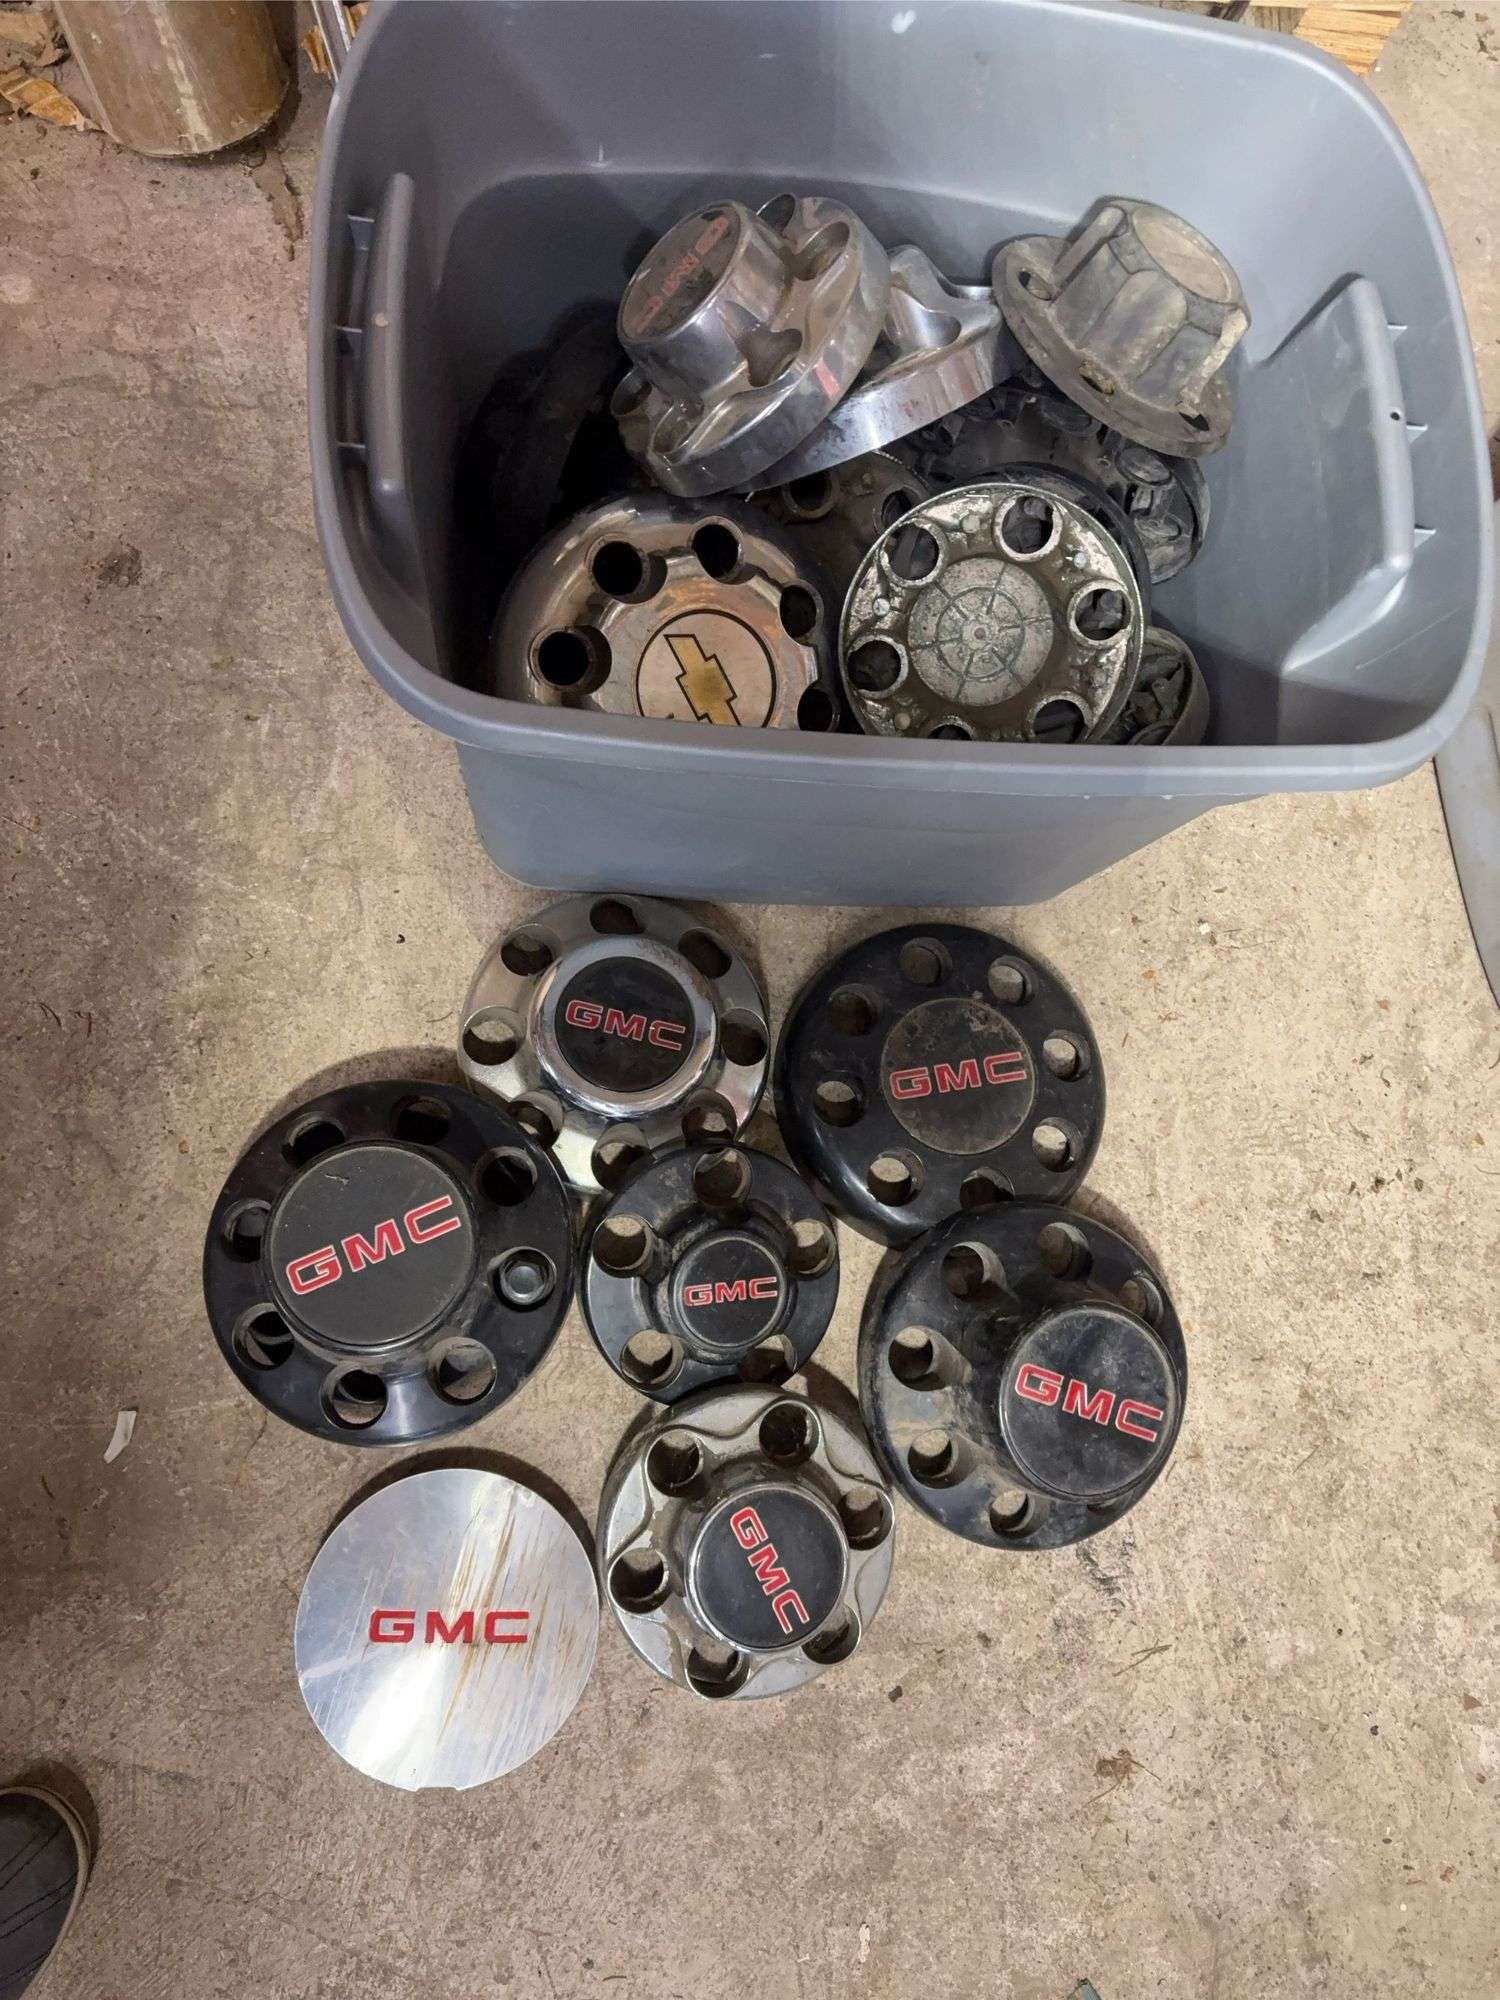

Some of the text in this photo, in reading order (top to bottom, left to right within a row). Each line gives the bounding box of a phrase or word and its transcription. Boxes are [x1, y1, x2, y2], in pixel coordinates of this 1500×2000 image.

[565, 1000, 686, 1051] GMC
[889, 1051, 1028, 1101] GMC
[286, 1196, 460, 1295] GMC
[685, 1276, 779, 1307] GMC
[1015, 1363, 1163, 1442] GMC
[729, 1507, 810, 1634] GMC
[369, 1610, 529, 1645] GMC
